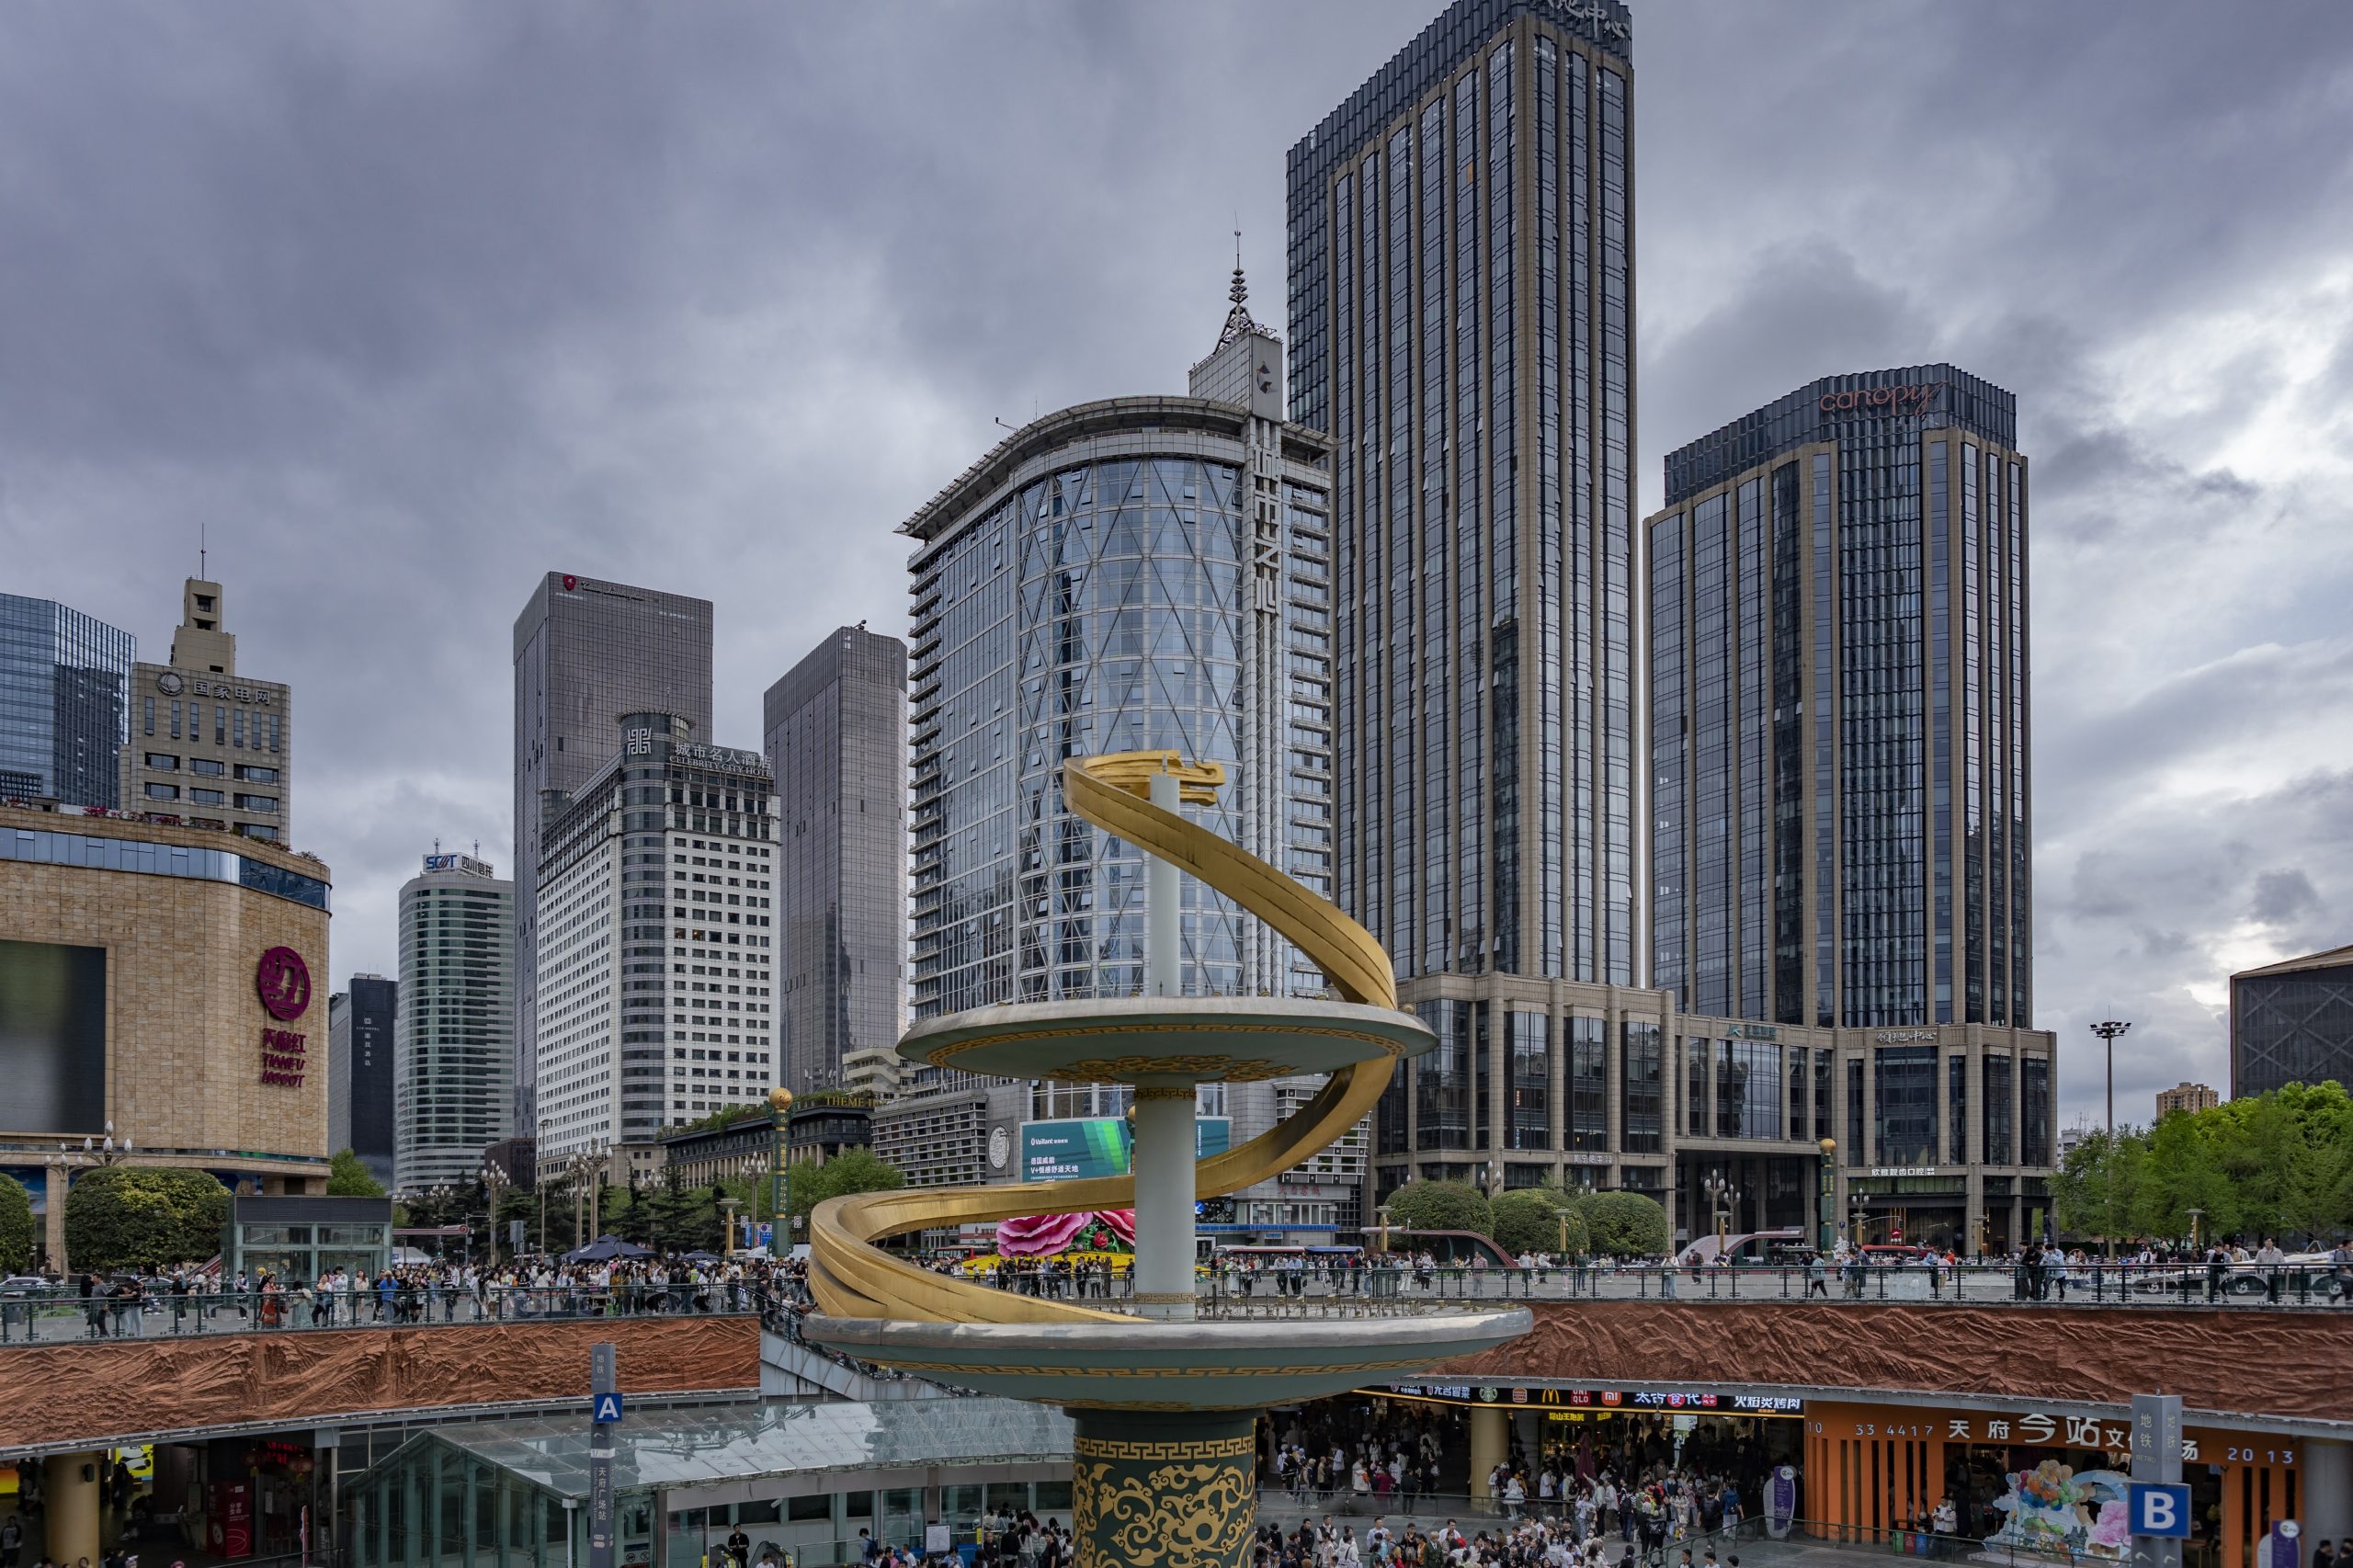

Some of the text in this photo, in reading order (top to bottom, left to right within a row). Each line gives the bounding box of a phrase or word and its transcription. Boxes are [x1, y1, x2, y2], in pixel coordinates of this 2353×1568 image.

[1820, 381, 1949, 416] canopy
[193, 680, 270, 706] 国家电网
[669, 755, 773, 778] CELEBRITY CITY HOTEL
[675, 742, 773, 769] 城市名人酒店
[461, 856, 494, 878] 四川信托
[262, 1028, 306, 1053] 天府红
[261, 1052, 306, 1071] TIANFU
[825, 1096, 864, 1108] THEME
[1030, 1156, 1055, 1165] 德国威能
[597, 1353, 605, 1375] 地铁
[597, 1397, 619, 1419] A
[1573, 1395, 1588, 1403] QLO
[1855, 1424, 1875, 1436] 33
[2140, 1413, 2153, 1449] 地铁
[2166, 1415, 2177, 1449] 地铁
[598, 1467, 607, 1521] 天府广场站
[2144, 1491, 2176, 1529] B
